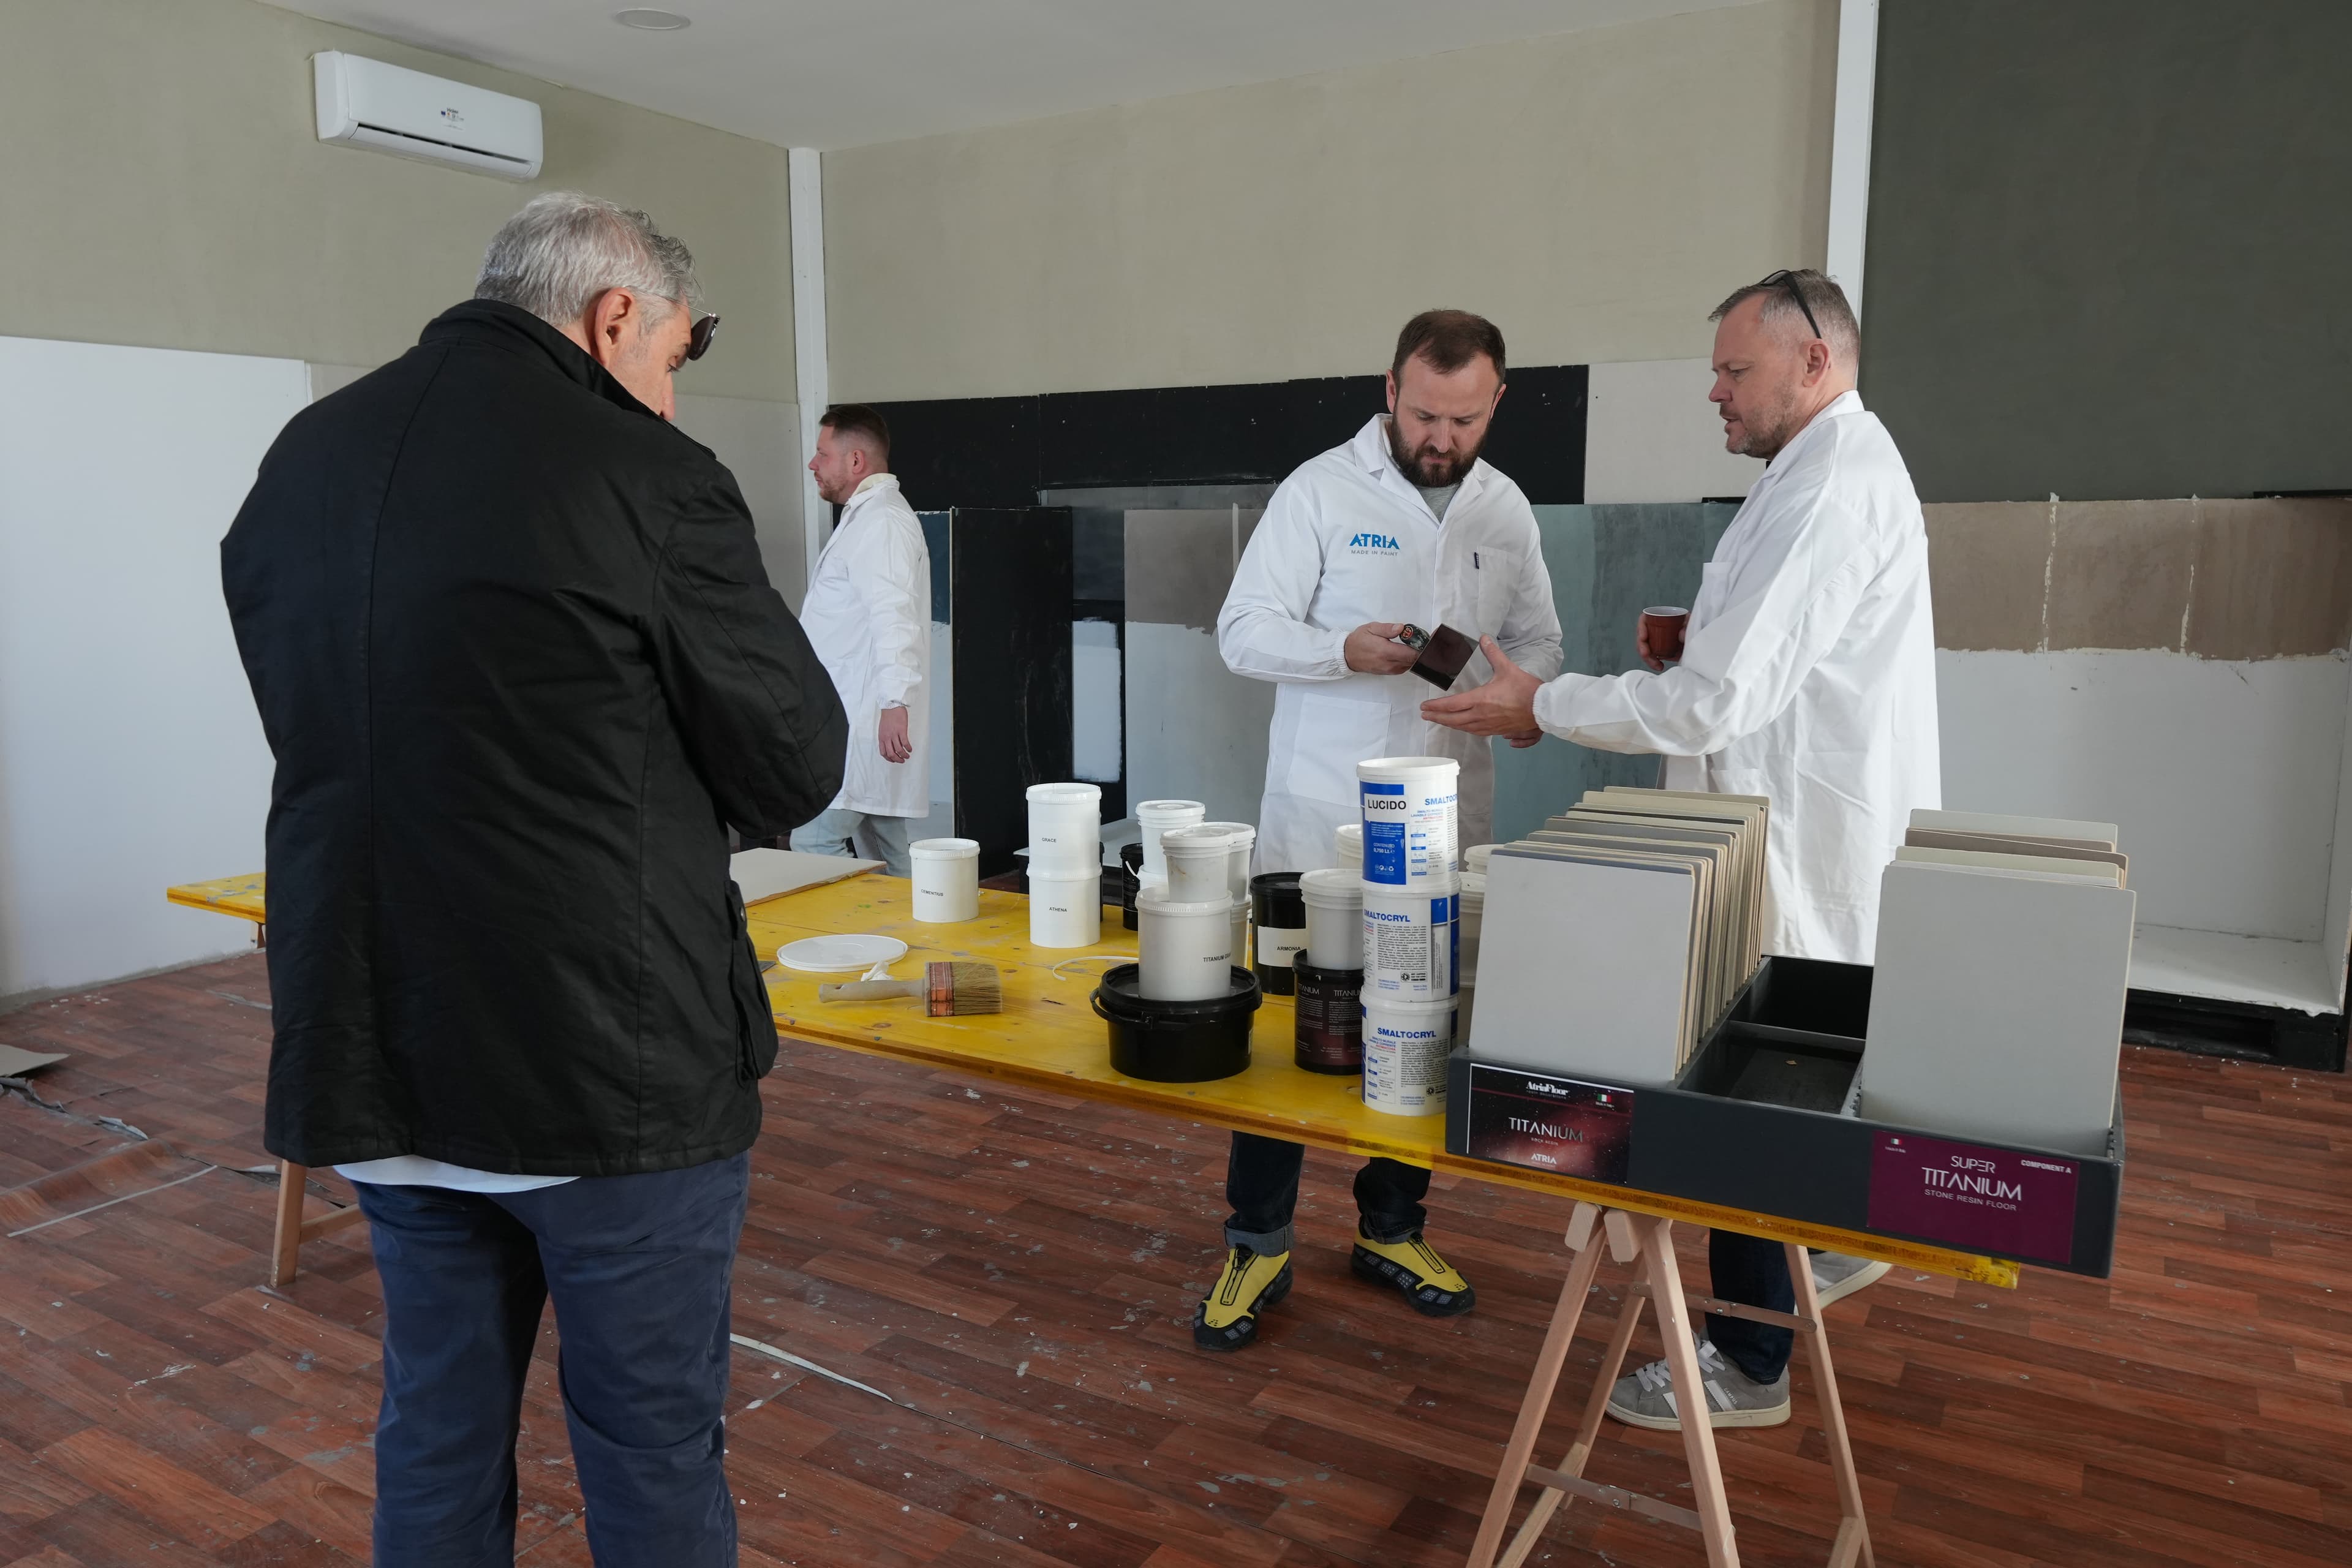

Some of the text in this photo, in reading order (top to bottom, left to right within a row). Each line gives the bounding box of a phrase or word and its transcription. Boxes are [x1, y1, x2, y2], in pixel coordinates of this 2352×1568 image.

[1349, 533, 1400, 550] ATRIA
[1368, 799, 1406, 810] LUCIDO
[1378, 1027, 1436, 1039] SMALTOCRYL
[1526, 1081, 1570, 1096] AtriaFloor
[1508, 1117, 1584, 1142] TITANIUM
[1531, 1153, 1557, 1164] ATRIA
[1950, 1156, 1996, 1174] SUPER
[2021, 1159, 2065, 1172] COMPONENT
[1921, 1167, 2022, 1201] TITANIUM
[1924, 1189, 2017, 1212] STONE RESIN FLOOR
[1724, 1387, 1738, 1404] CAMPUS
